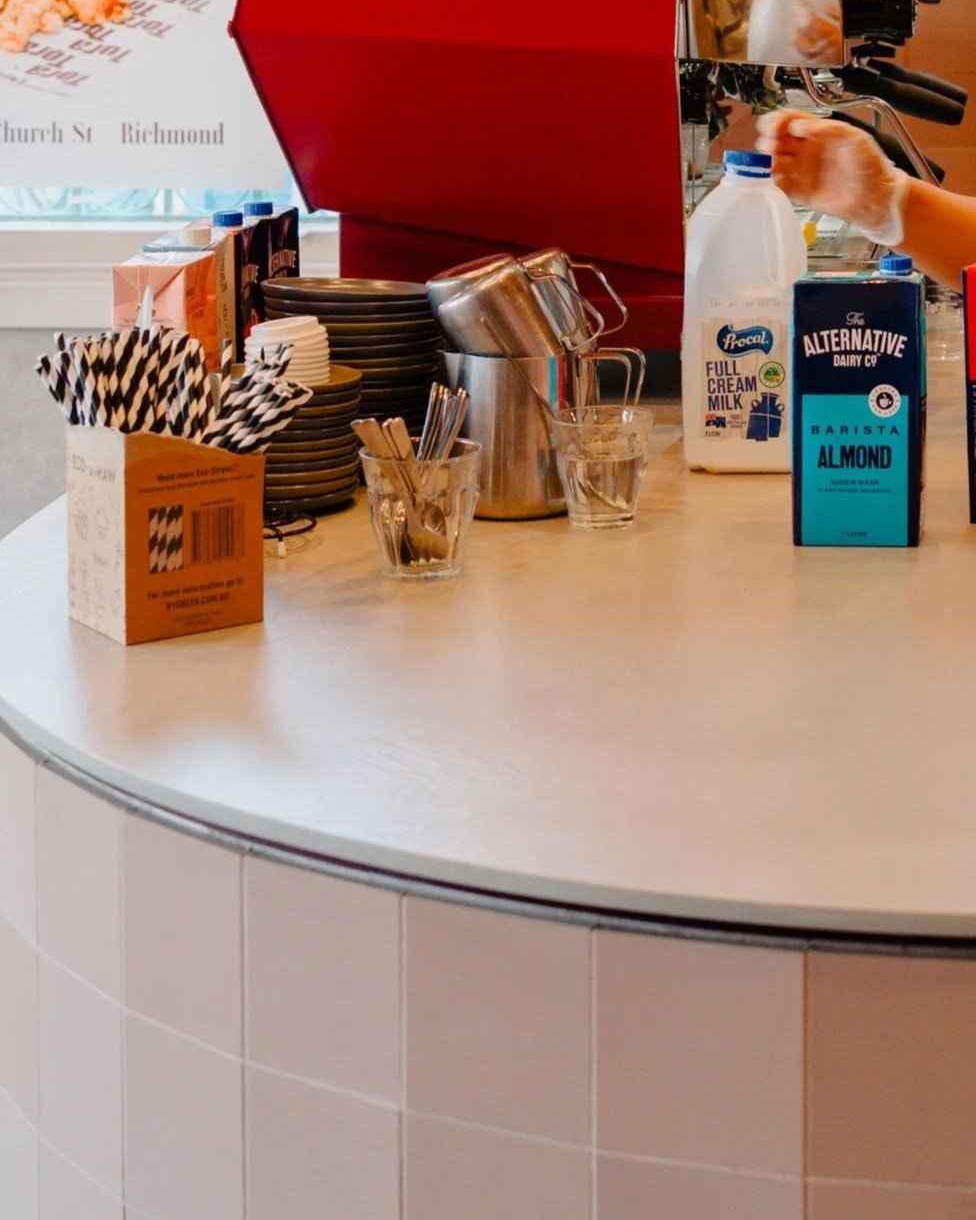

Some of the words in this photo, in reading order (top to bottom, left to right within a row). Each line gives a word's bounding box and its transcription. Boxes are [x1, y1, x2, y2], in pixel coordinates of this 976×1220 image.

[72, 123, 93, 144] St
[121, 122, 224, 145] Richmond
[846, 312, 865, 326] The
[803, 328, 908, 358] ALTERNATIVE
[706, 360, 740, 377] FULL
[833, 354, 862, 367] DAIRY
[707, 376, 757, 395] CREAM
[708, 394, 743, 411] MILK
[811, 426, 899, 435] BARISTA
[818, 445, 893, 469] ALMOND
